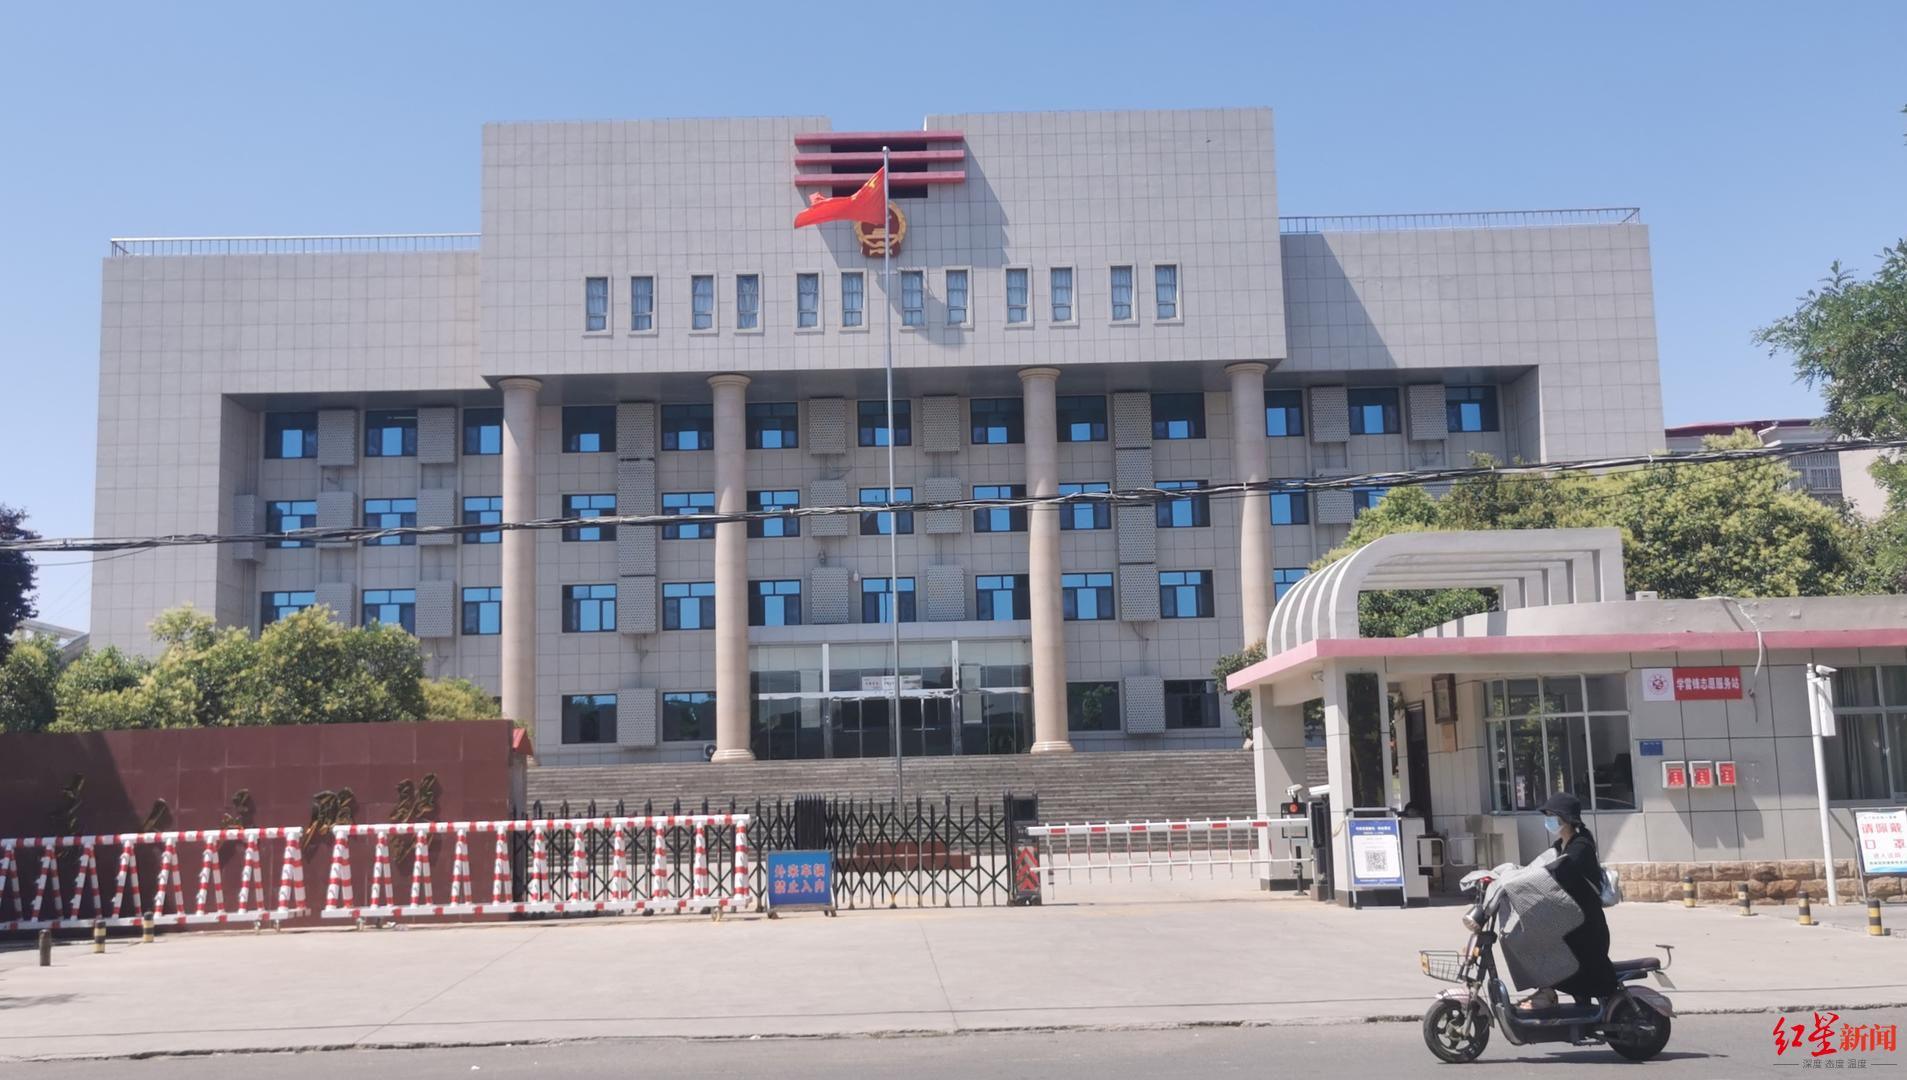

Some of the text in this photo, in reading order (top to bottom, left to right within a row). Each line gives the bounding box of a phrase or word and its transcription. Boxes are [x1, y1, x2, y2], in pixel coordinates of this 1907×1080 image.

[774, 864, 826, 879] 外来车辆
[774, 879, 826, 895] 禁止入内
